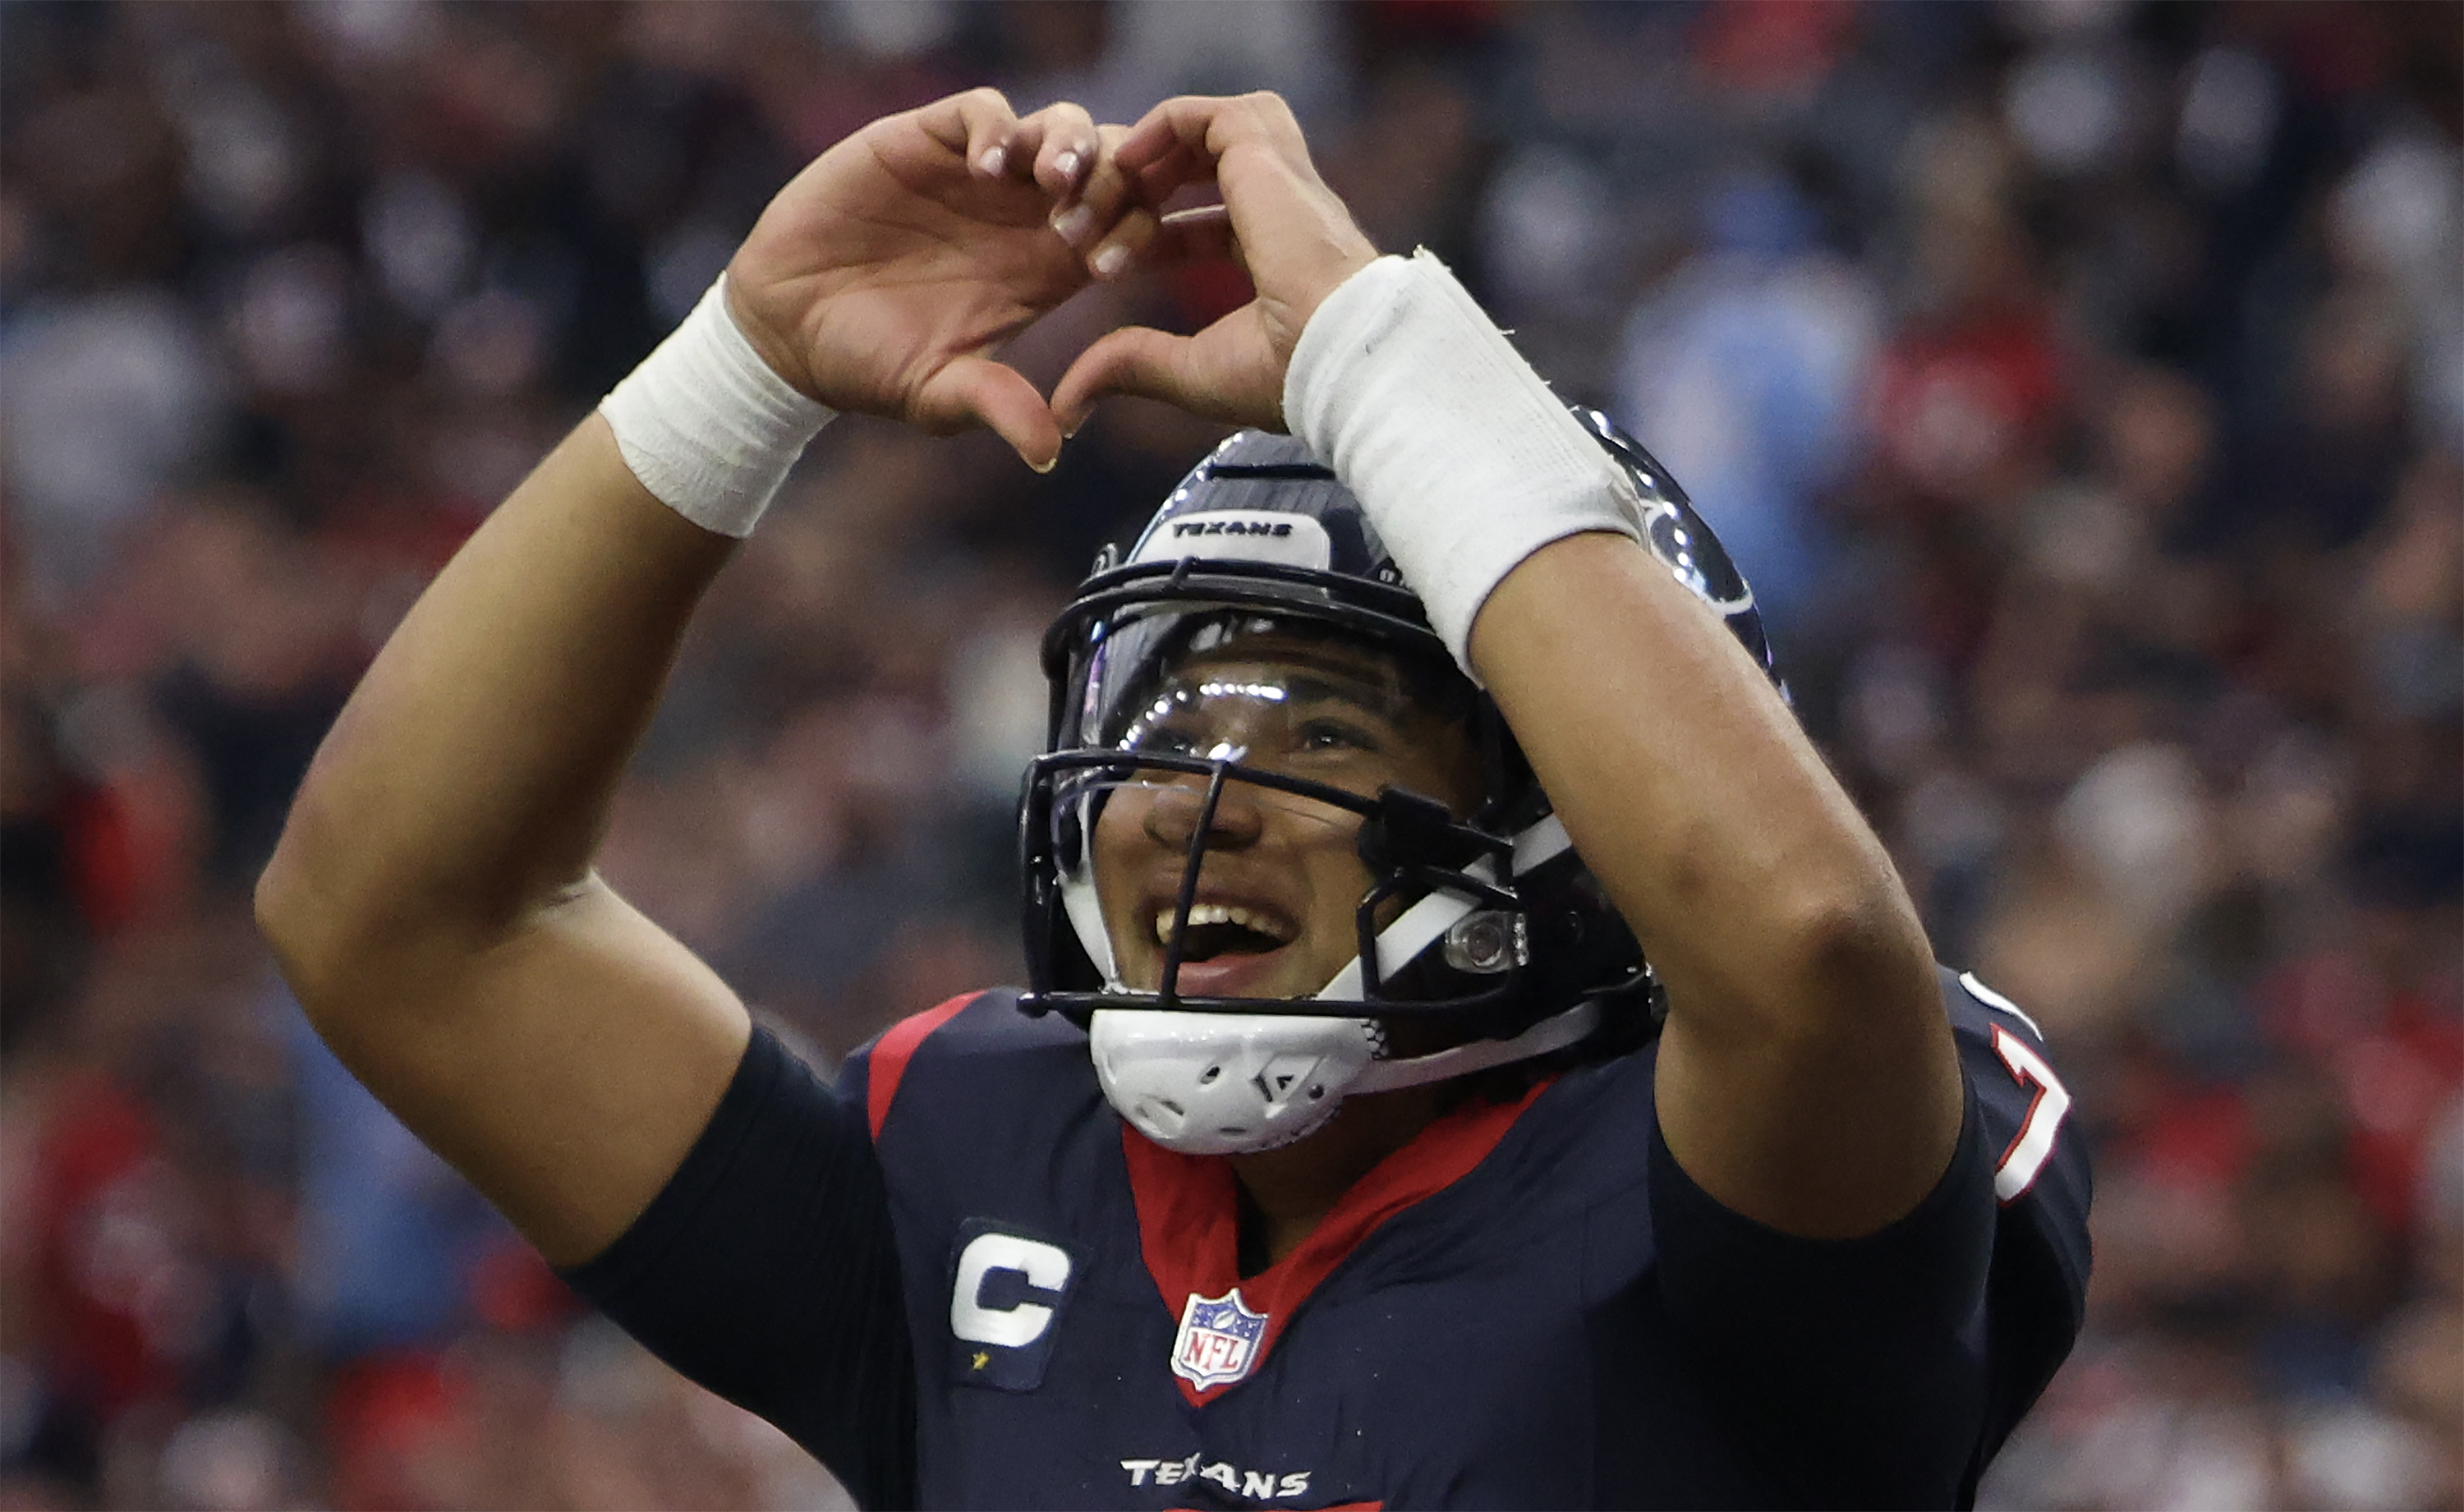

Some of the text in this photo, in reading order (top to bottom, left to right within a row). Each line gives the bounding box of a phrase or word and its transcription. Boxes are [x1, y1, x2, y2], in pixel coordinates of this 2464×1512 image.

[1173, 522, 1293, 538] TEXANS
[1988, 1023, 2072, 1207] 7
[951, 1234, 1070, 1348] C
[1184, 1331, 1239, 1370] NFL
[1120, 1452, 1312, 1500] TEXANS
